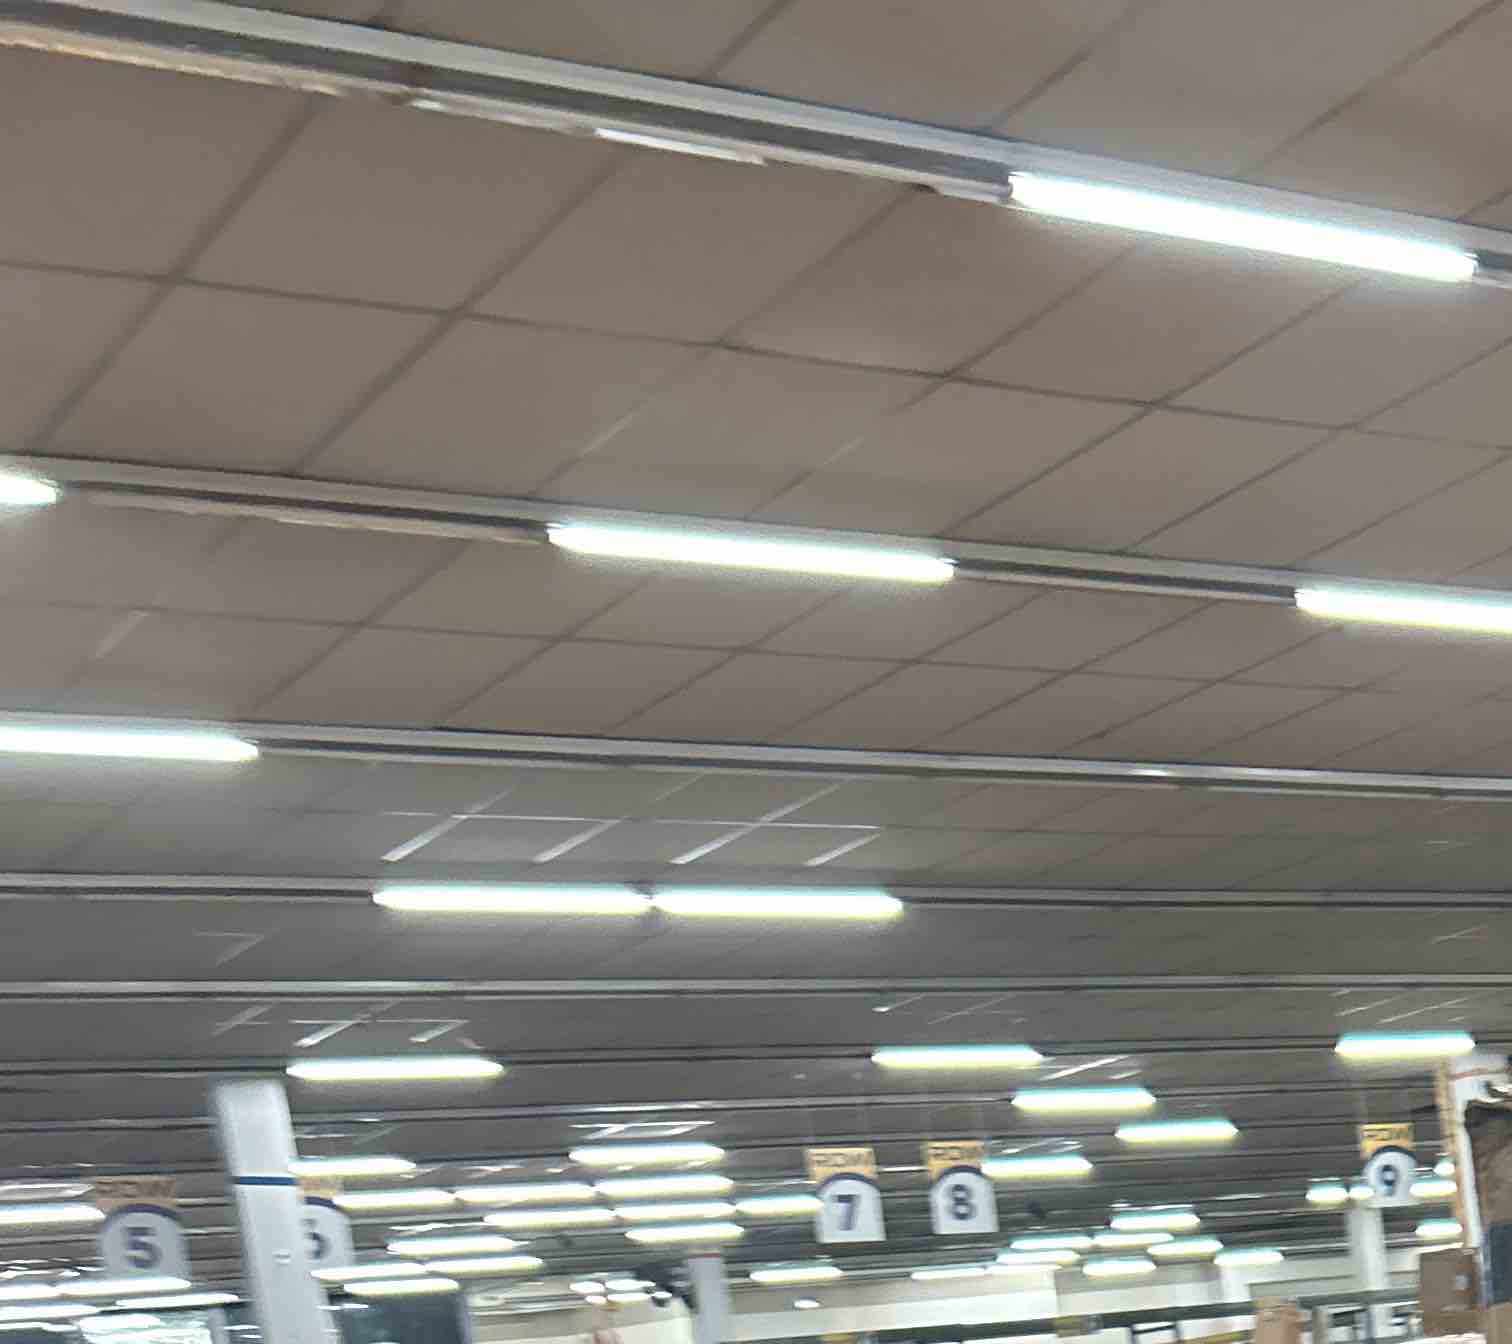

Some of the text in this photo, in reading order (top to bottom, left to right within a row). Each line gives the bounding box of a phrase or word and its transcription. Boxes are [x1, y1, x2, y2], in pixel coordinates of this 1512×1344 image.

[1376, 1164, 1399, 1197] 9
[830, 1193, 860, 1231] 7
[949, 1183, 978, 1221] 8
[122, 1226, 162, 1269] 5
